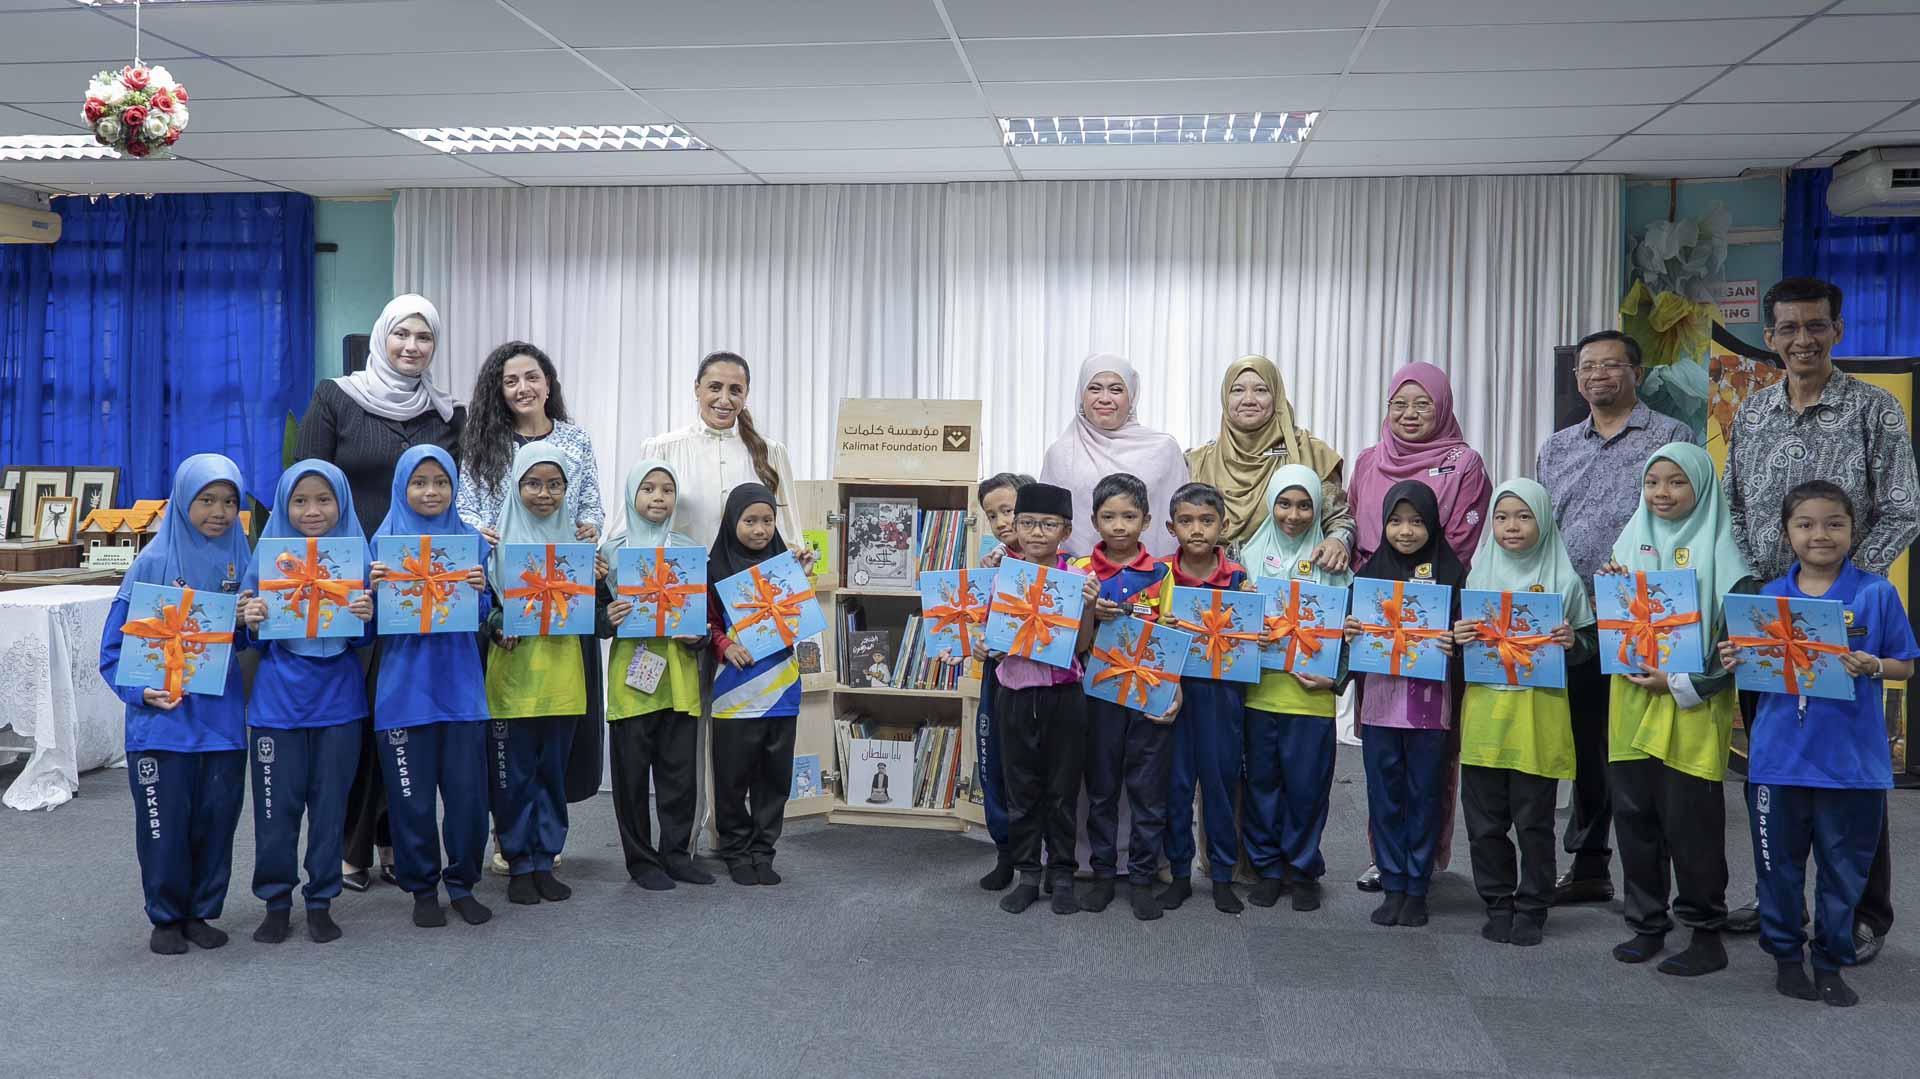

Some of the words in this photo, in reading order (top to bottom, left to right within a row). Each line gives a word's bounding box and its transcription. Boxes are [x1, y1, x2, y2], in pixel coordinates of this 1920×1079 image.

[1720, 308, 1750, 318] ING
[842, 441, 879, 451] Kalimat
[881, 441, 938, 452] Foundation
[844, 424, 884, 436] كلمات
[887, 425, 939, 438] مؤسسة
[396, 746, 412, 797] SKSBS
[497, 741, 507, 789] SKSBS
[146, 786, 160, 839] SKSBS
[262, 765, 272, 819] SKSBS
[1760, 815, 1771, 871] SKSBS
